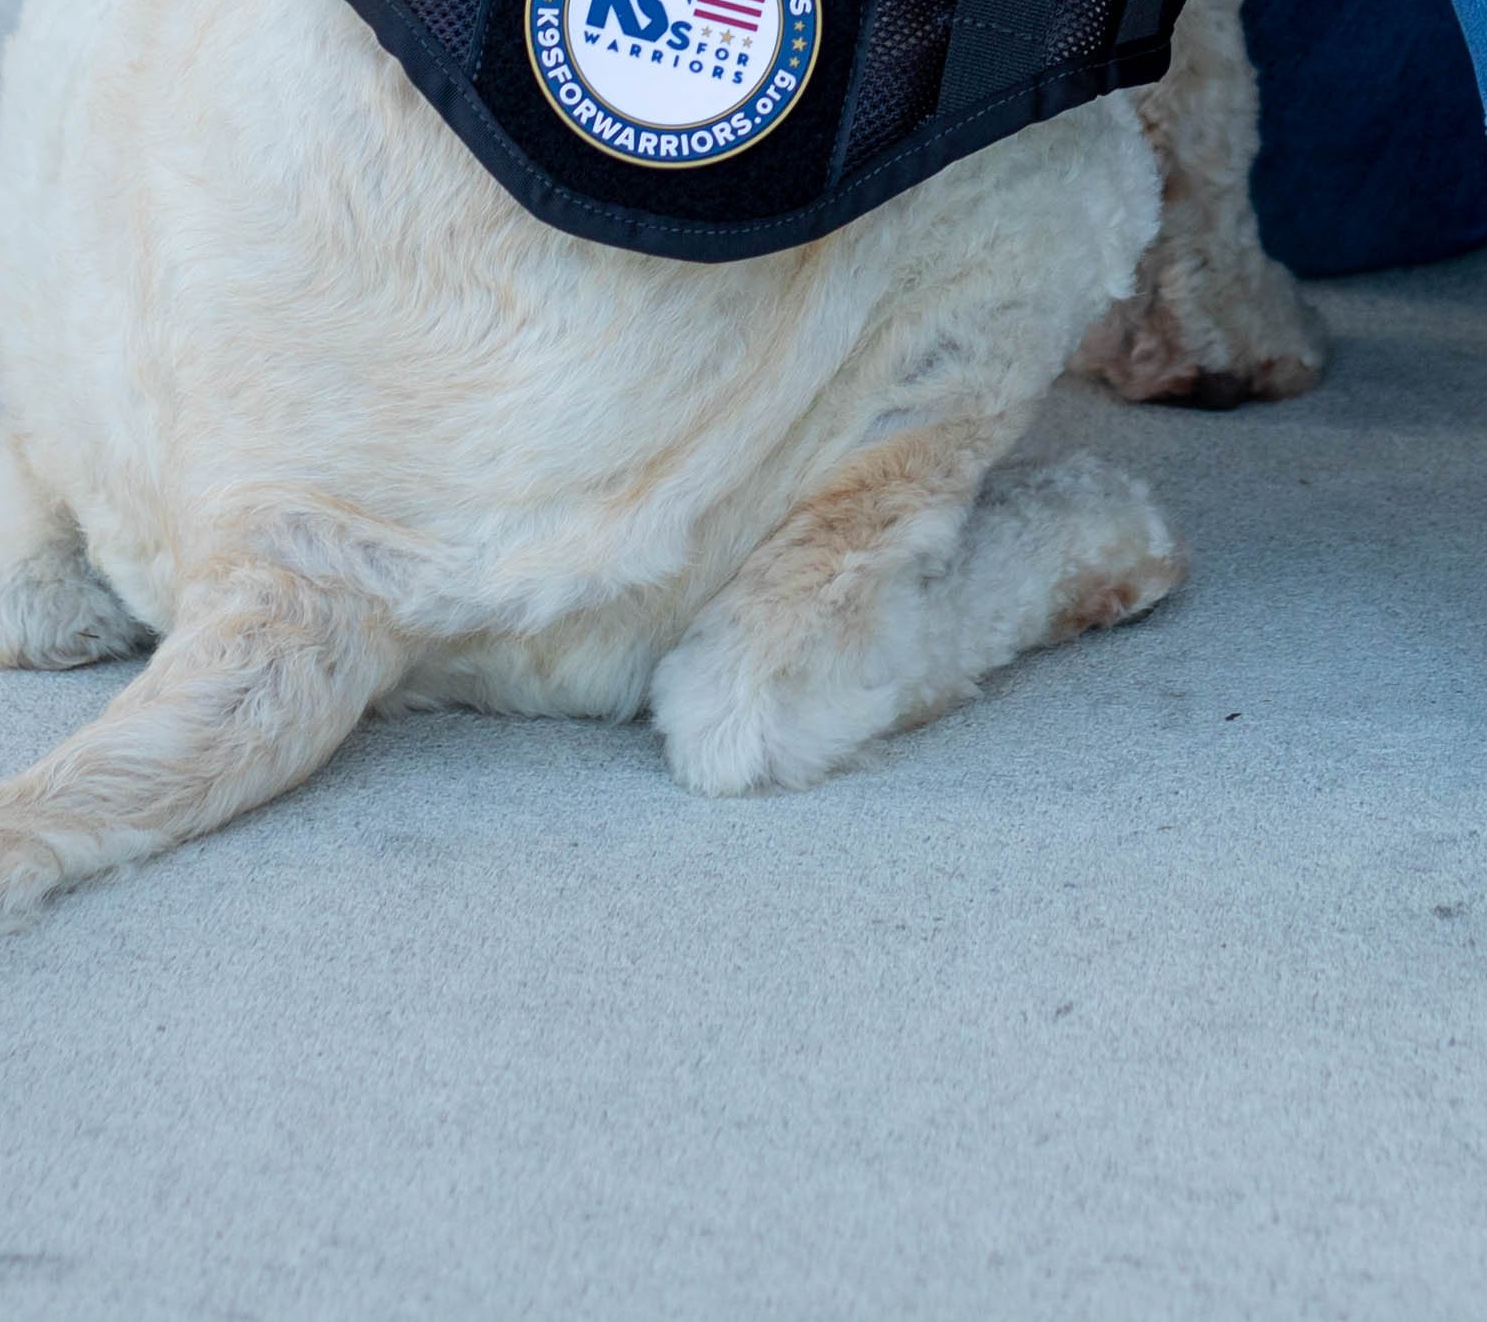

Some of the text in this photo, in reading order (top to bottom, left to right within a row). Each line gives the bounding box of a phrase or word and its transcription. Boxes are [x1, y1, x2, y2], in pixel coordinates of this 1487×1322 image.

[536, 7, 796, 157] K9SFORWARRIORS.org
[583, 29, 744, 85] WARRIORS
[696, 42, 750, 67] FOR
